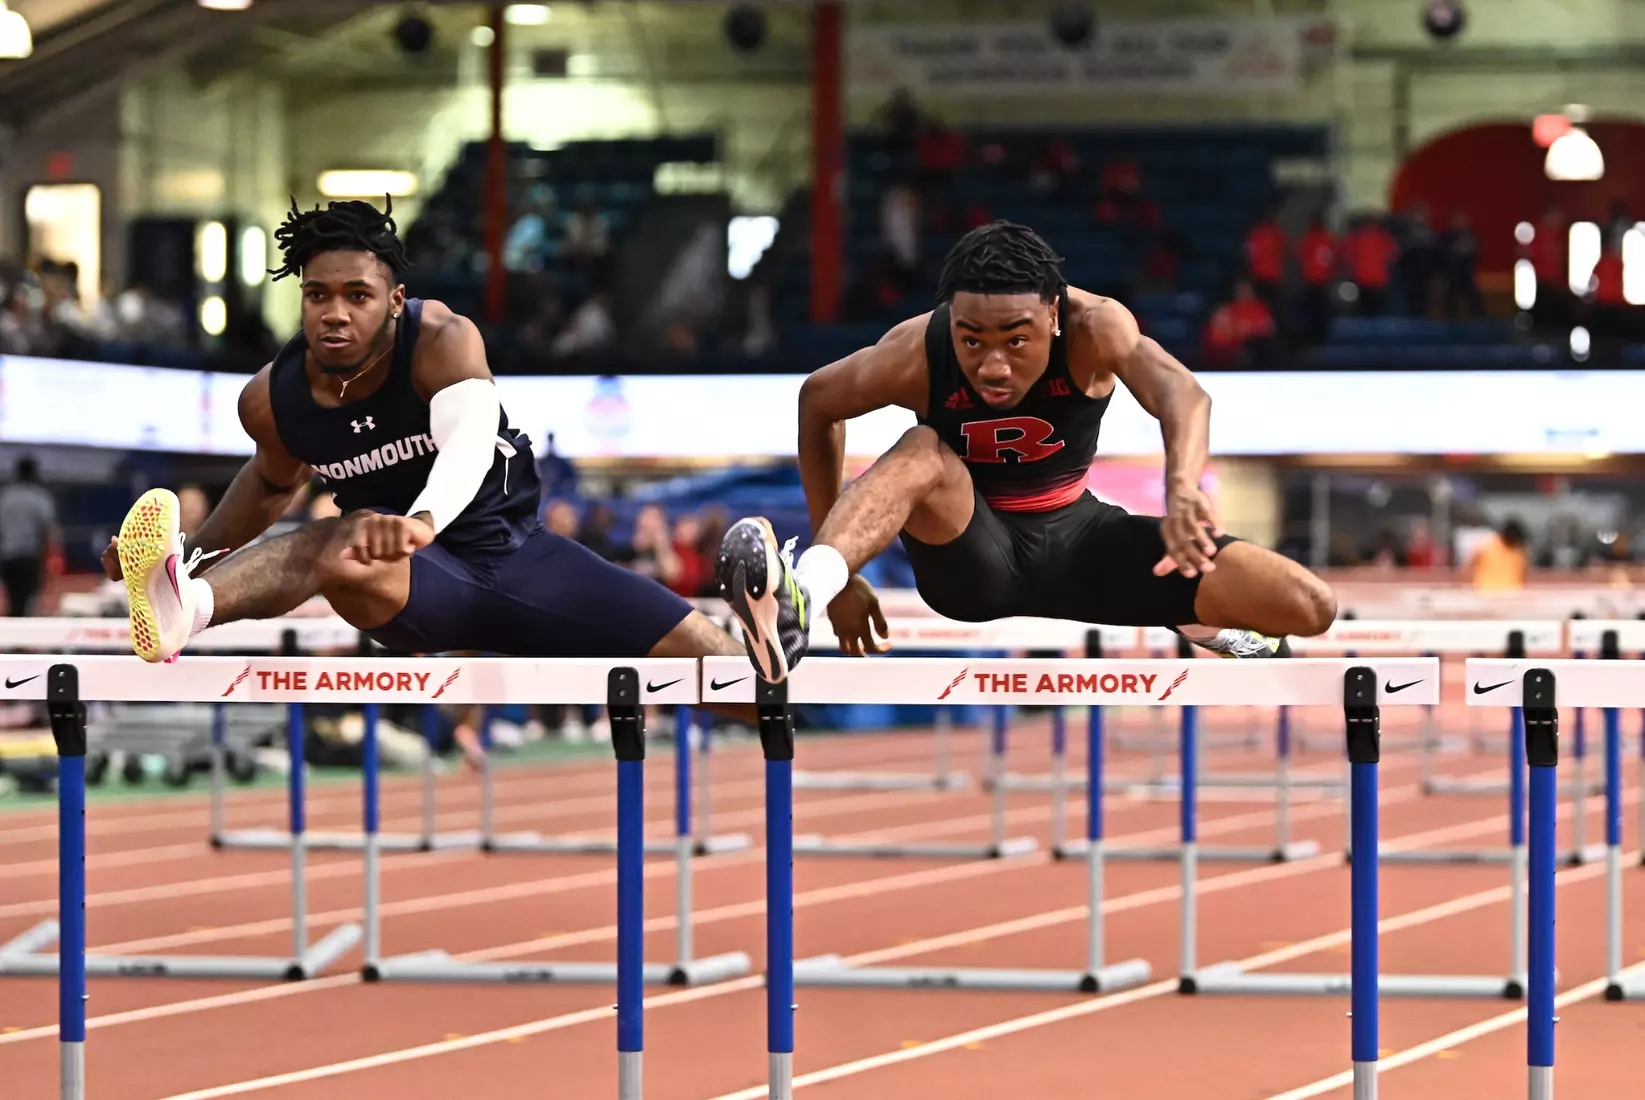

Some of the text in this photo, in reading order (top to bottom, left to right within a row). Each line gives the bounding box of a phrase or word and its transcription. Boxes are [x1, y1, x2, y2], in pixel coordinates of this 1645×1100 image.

[959, 416, 1066, 463] R
[256, 671, 432, 692] THE ARMORY
[974, 673, 1158, 694] THE ARMORY
